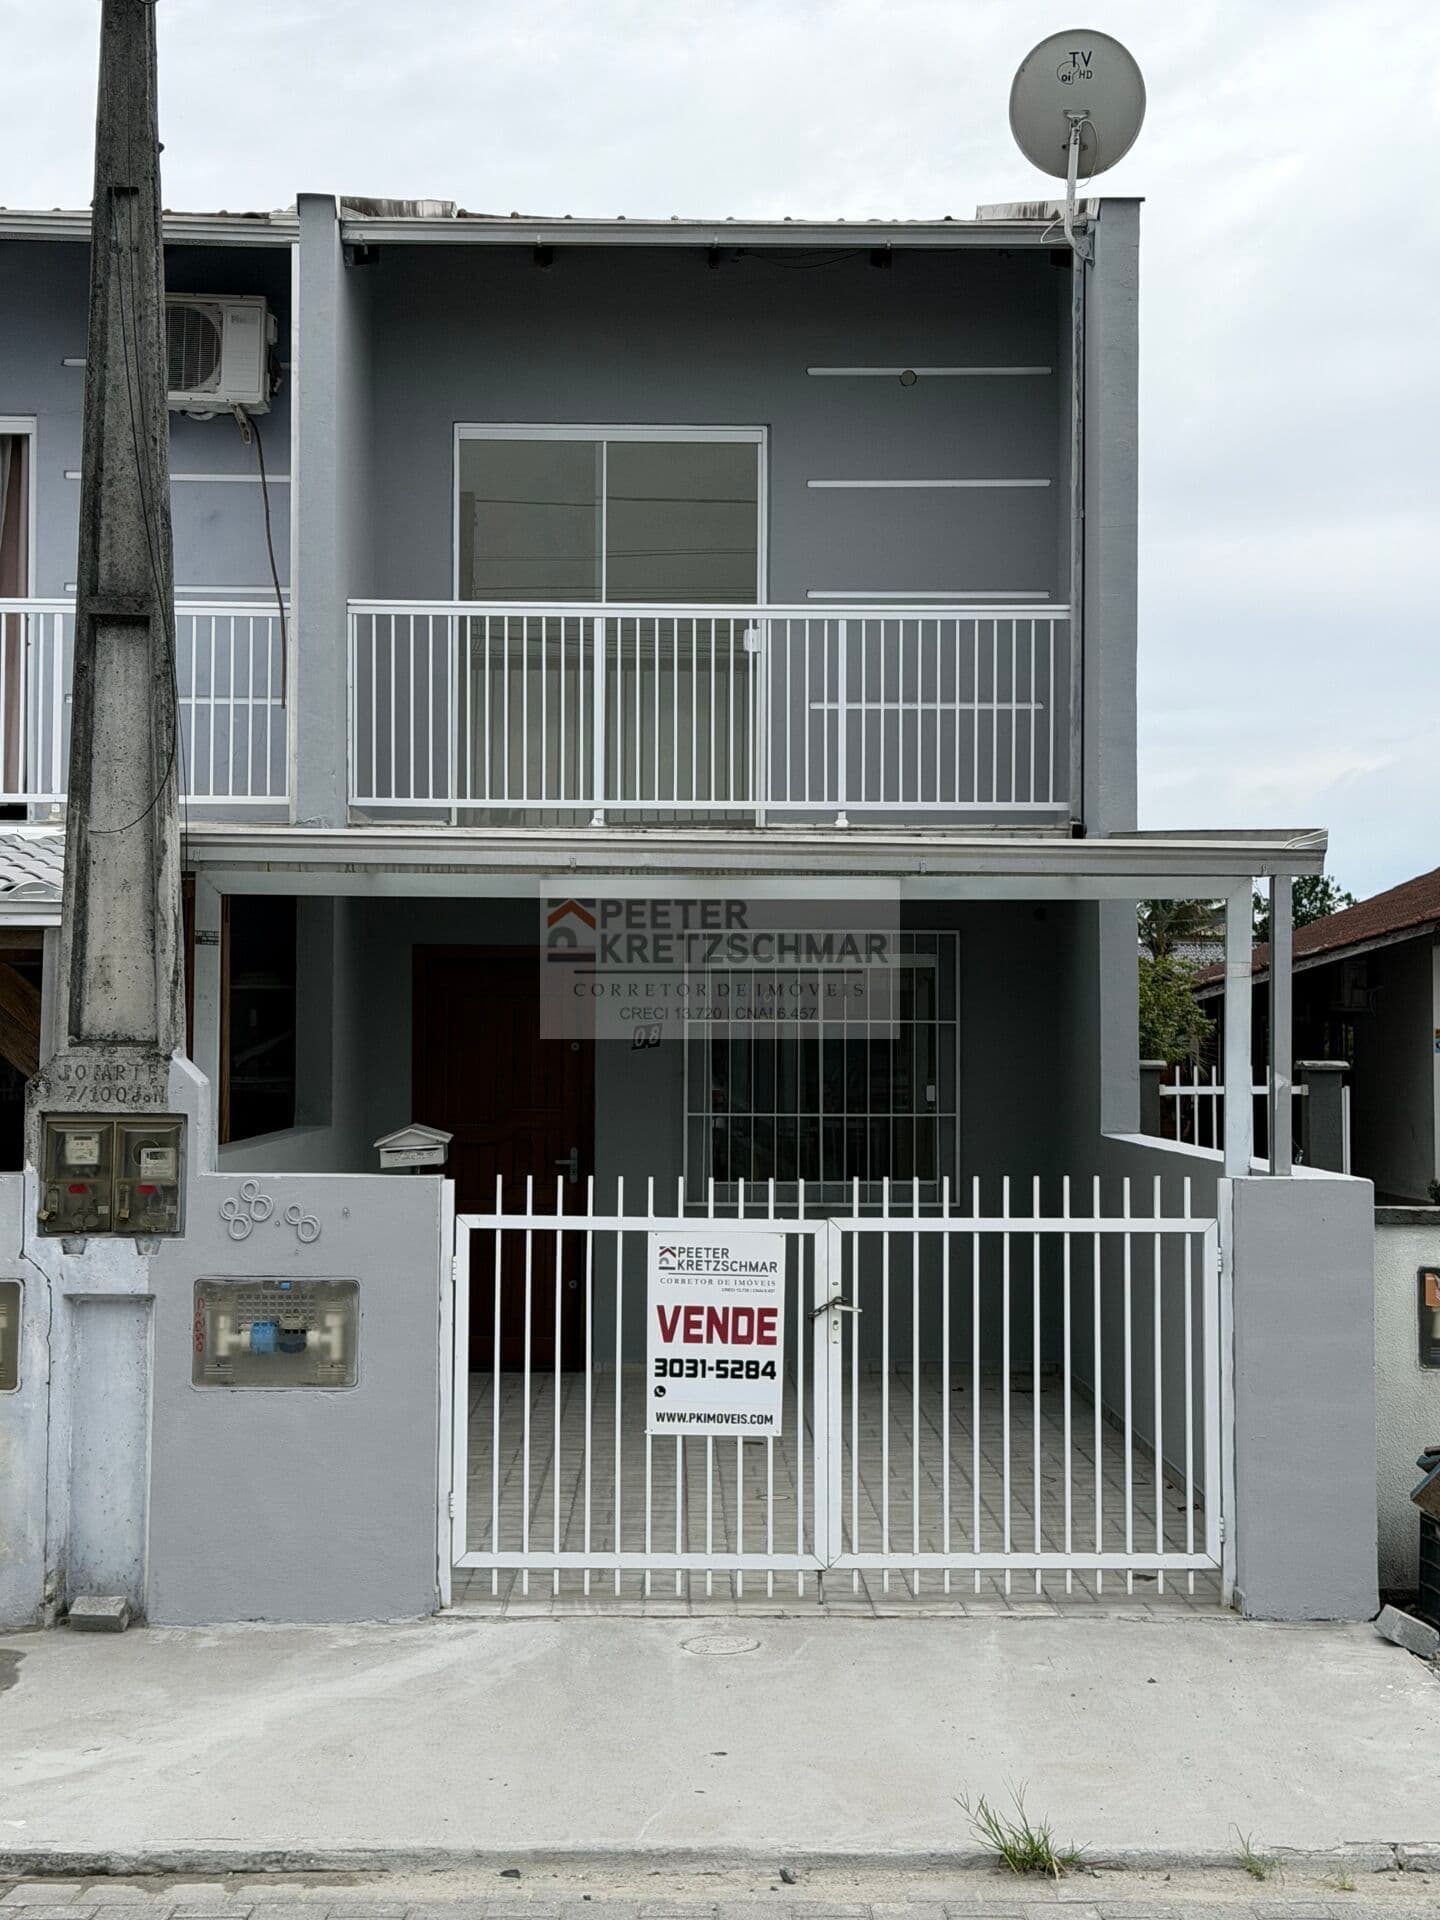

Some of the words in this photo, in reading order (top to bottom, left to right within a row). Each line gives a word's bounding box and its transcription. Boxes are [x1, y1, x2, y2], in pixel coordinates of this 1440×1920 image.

[1069, 51, 1092, 68] TV
[1061, 71, 1071, 82] oi
[1078, 70, 1093, 80] HD
[634, 1023, 661, 1046] 08
[677, 1246, 729, 1259] PEETER
[677, 1259, 778, 1273] KRETZSCHMAR
[660, 1277, 713, 1286] CORRETOR
[717, 1279, 731, 1287] DE
[656, 1305, 778, 1345] VENDE
[654, 1357, 777, 1380] 3031-5284
[655, 1411, 774, 1426] WWW.PKIMOVEIS.COM
